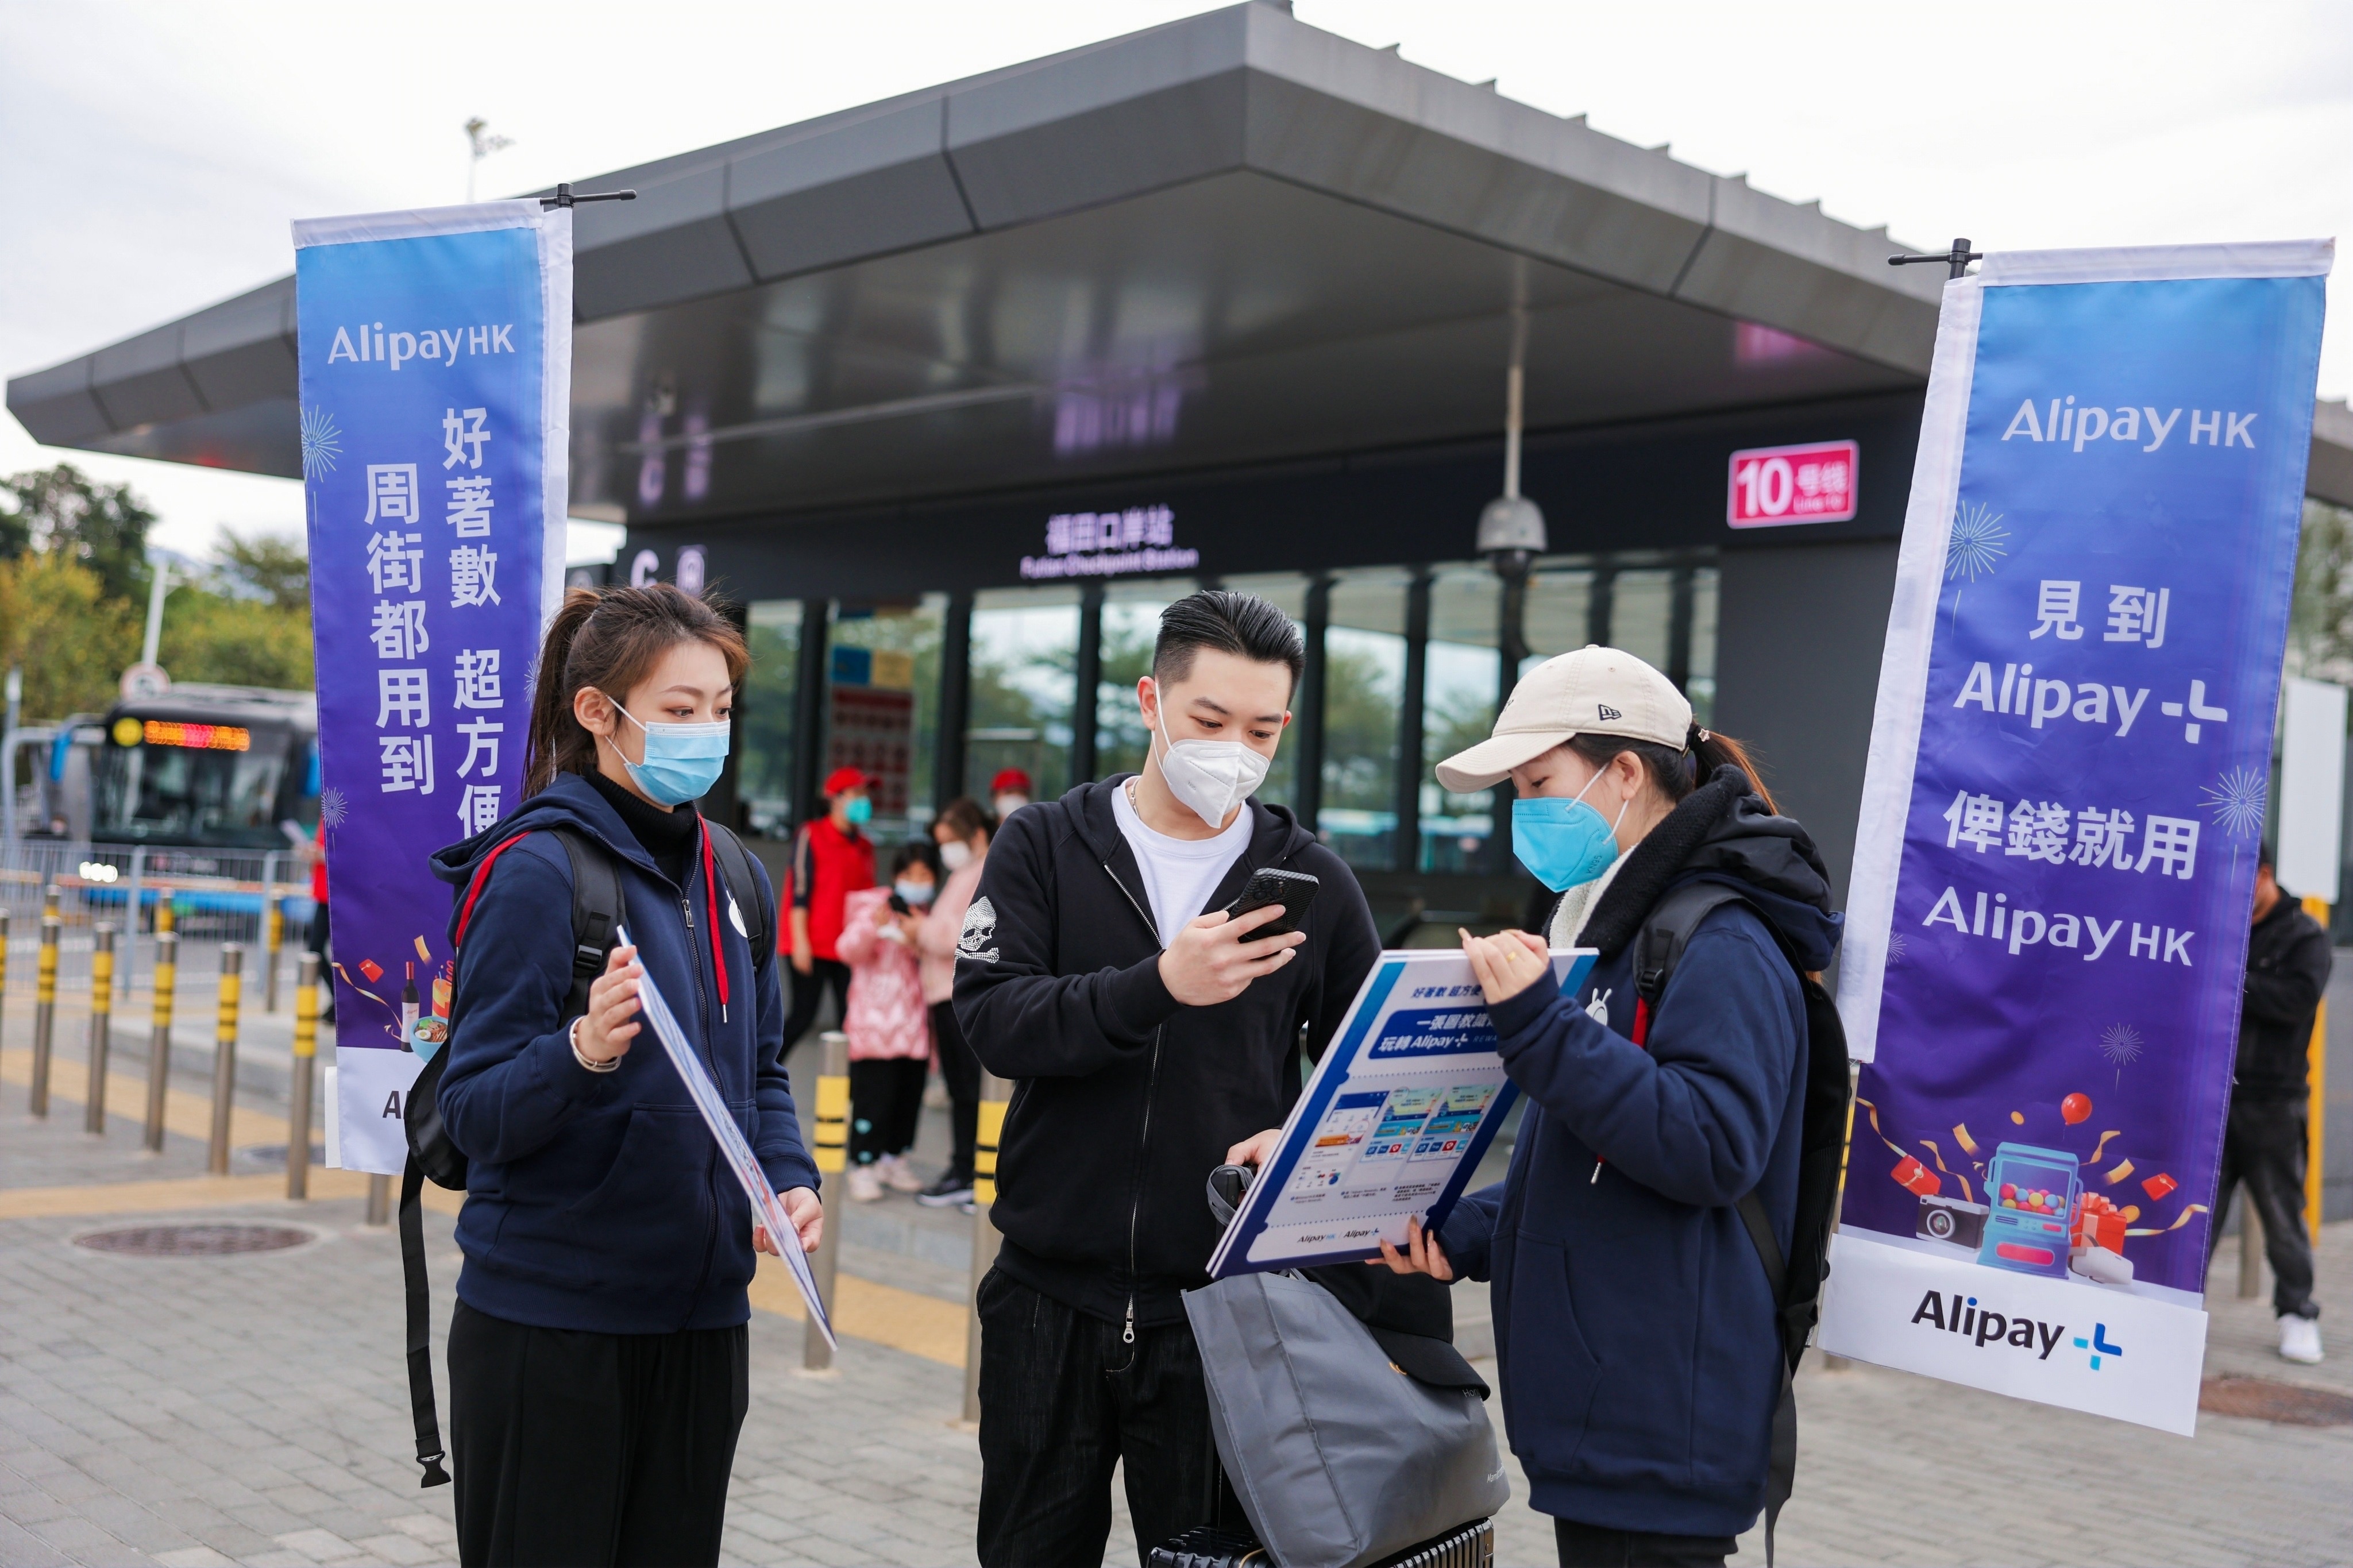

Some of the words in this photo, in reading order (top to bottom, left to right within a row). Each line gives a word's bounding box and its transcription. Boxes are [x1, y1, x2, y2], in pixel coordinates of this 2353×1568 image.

[364, 462, 435, 795] 周街都用到
[1943, 790, 2201, 880] 俾錢就用
